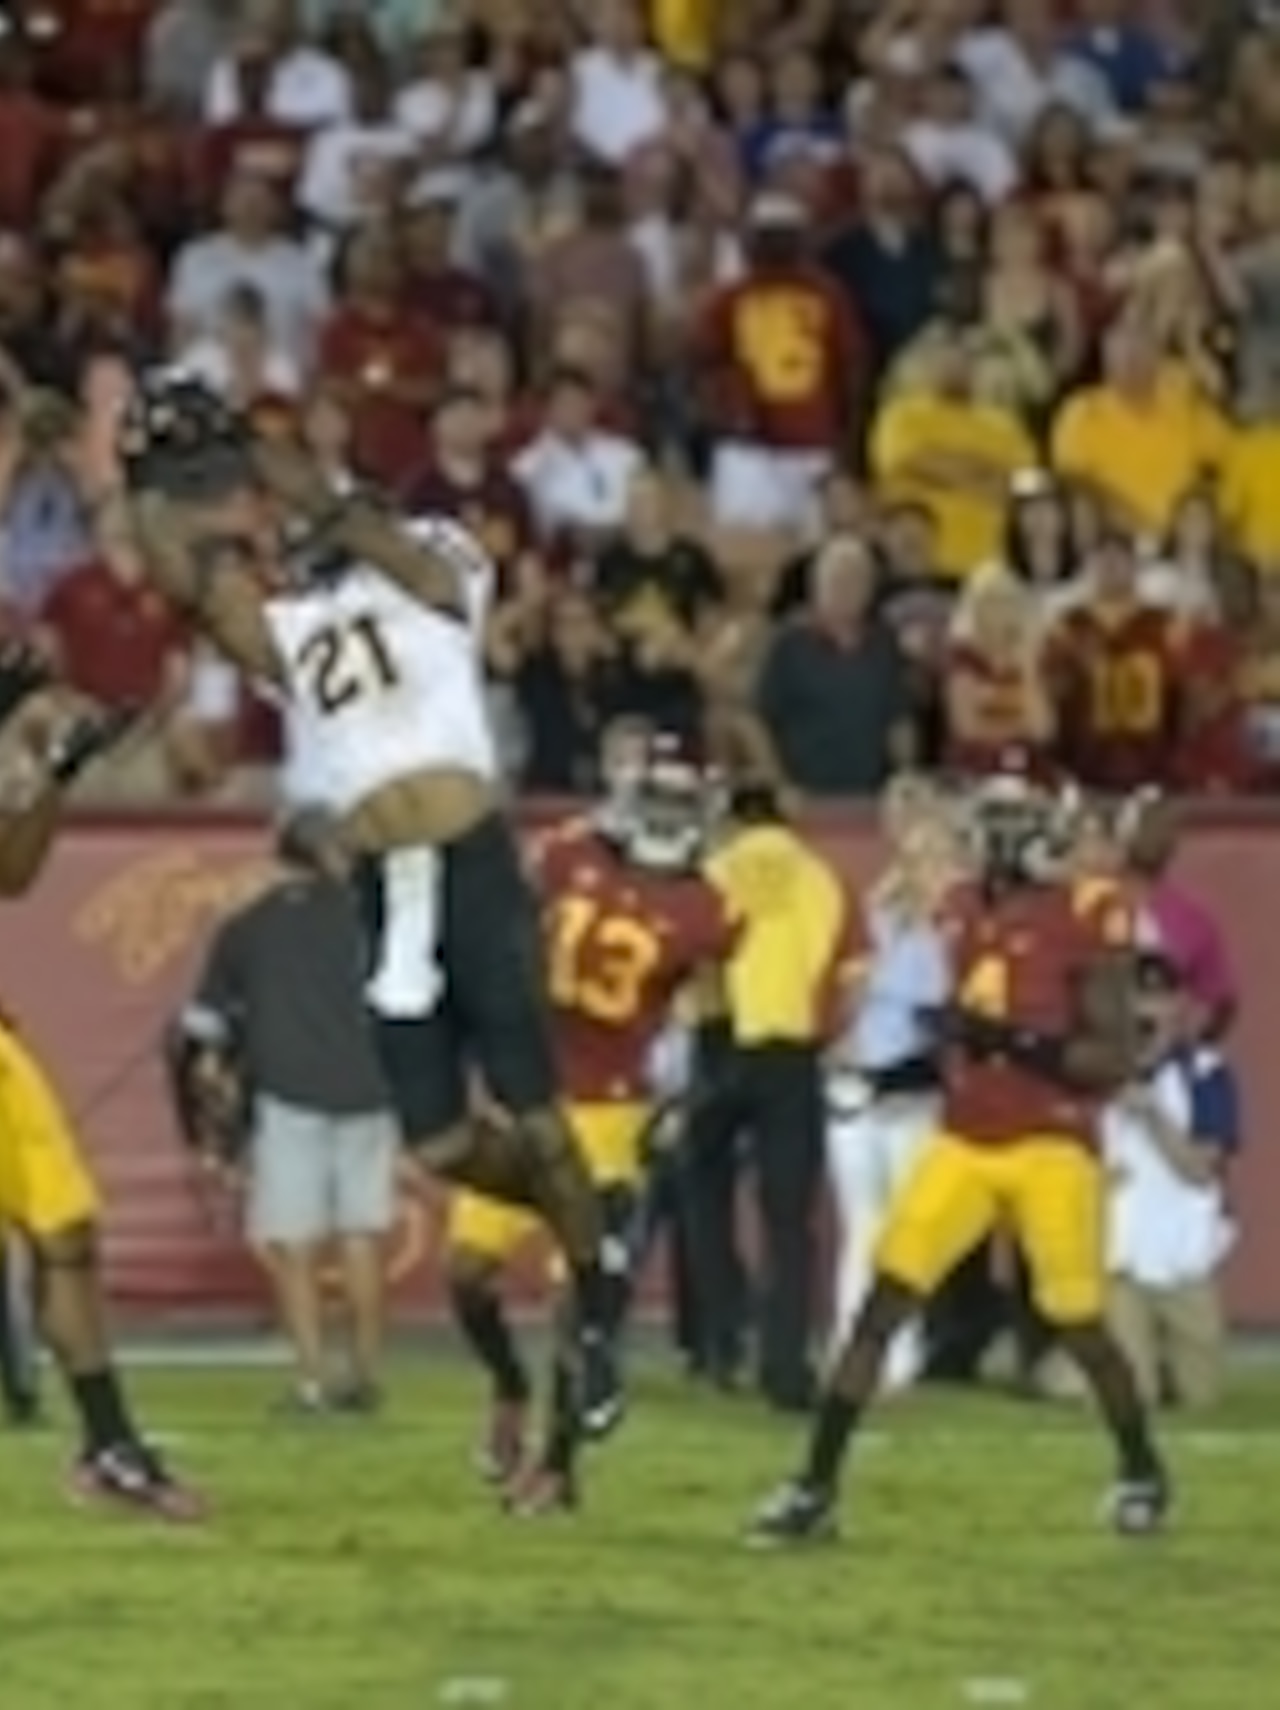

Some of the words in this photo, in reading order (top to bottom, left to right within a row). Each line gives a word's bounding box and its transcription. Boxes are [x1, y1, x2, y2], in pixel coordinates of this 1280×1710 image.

[298, 614, 397, 715] 21
[550, 896, 658, 1022] 13
[961, 956, 1008, 1018] 4
